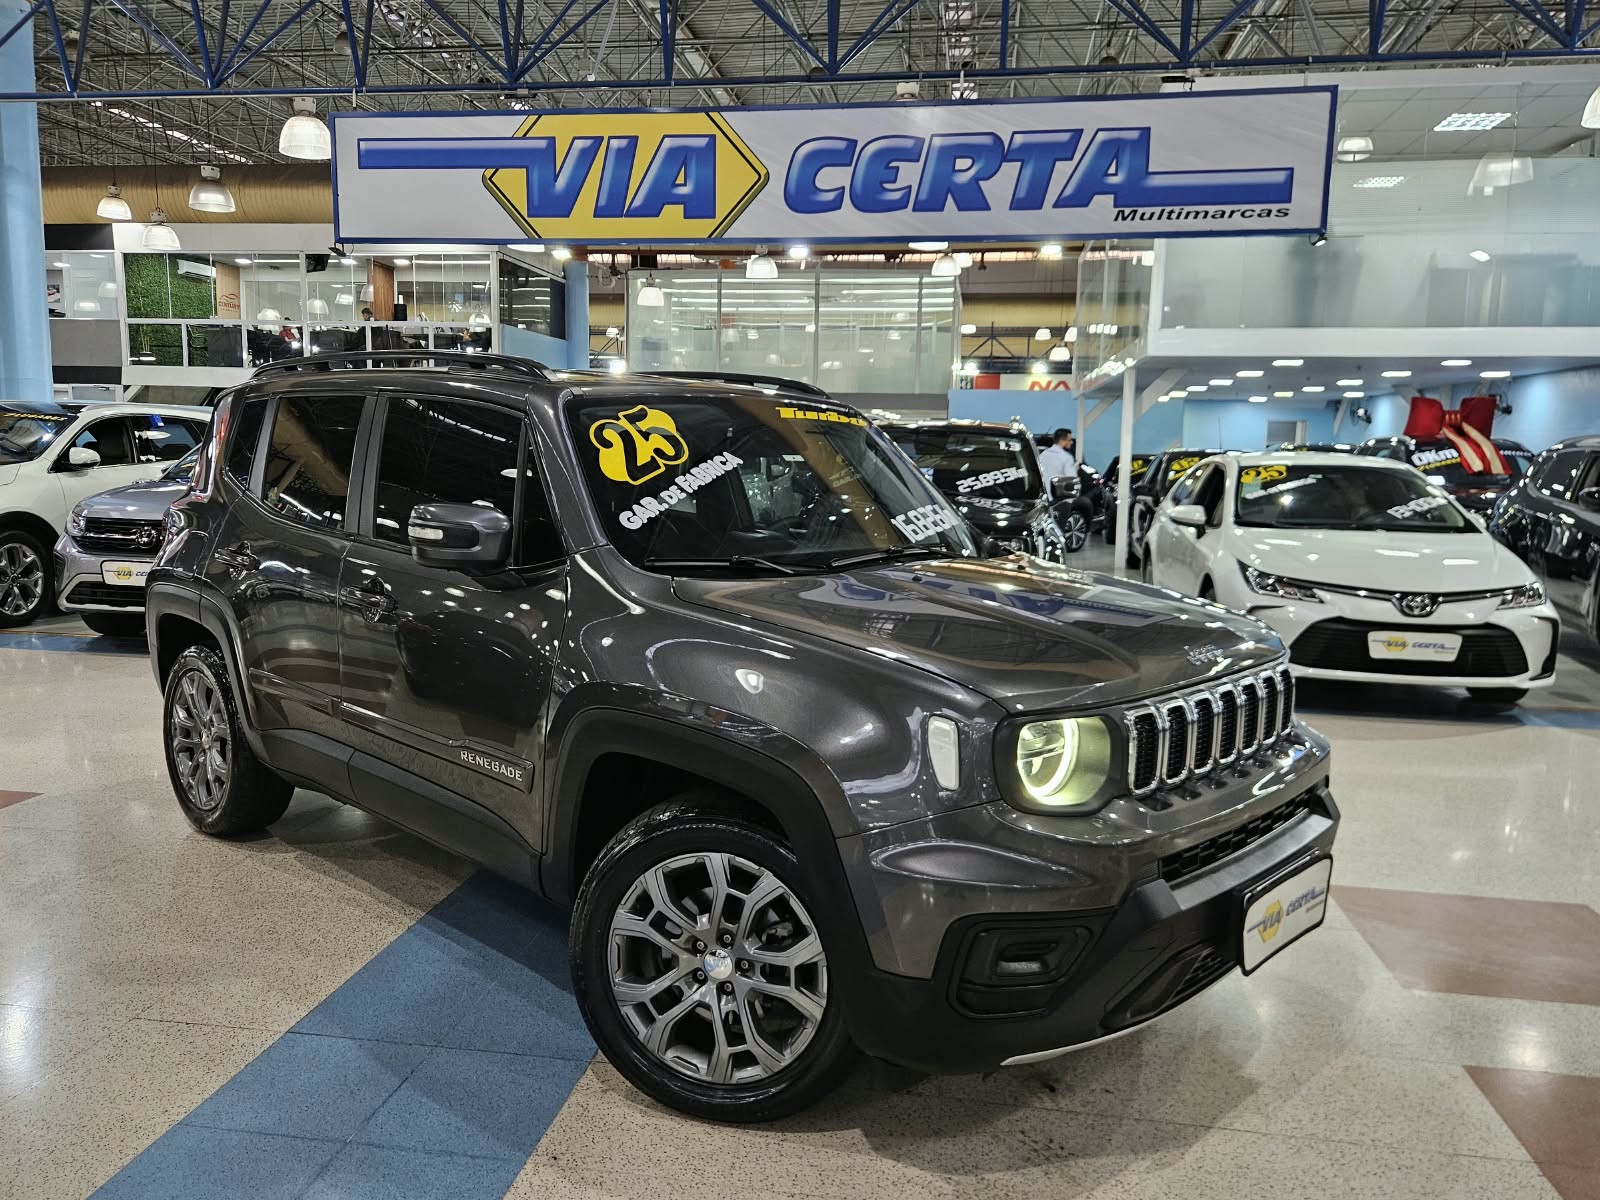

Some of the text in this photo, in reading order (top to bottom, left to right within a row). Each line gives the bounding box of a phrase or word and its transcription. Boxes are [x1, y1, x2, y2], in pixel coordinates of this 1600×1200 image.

[527, 127, 1150, 219] VIA CERTA
[1113, 207, 1291, 222] Multimarcas
[589, 404, 689, 486] 25
[674, 451, 744, 494] FABRICA
[460, 751, 522, 782] RENEGADE
